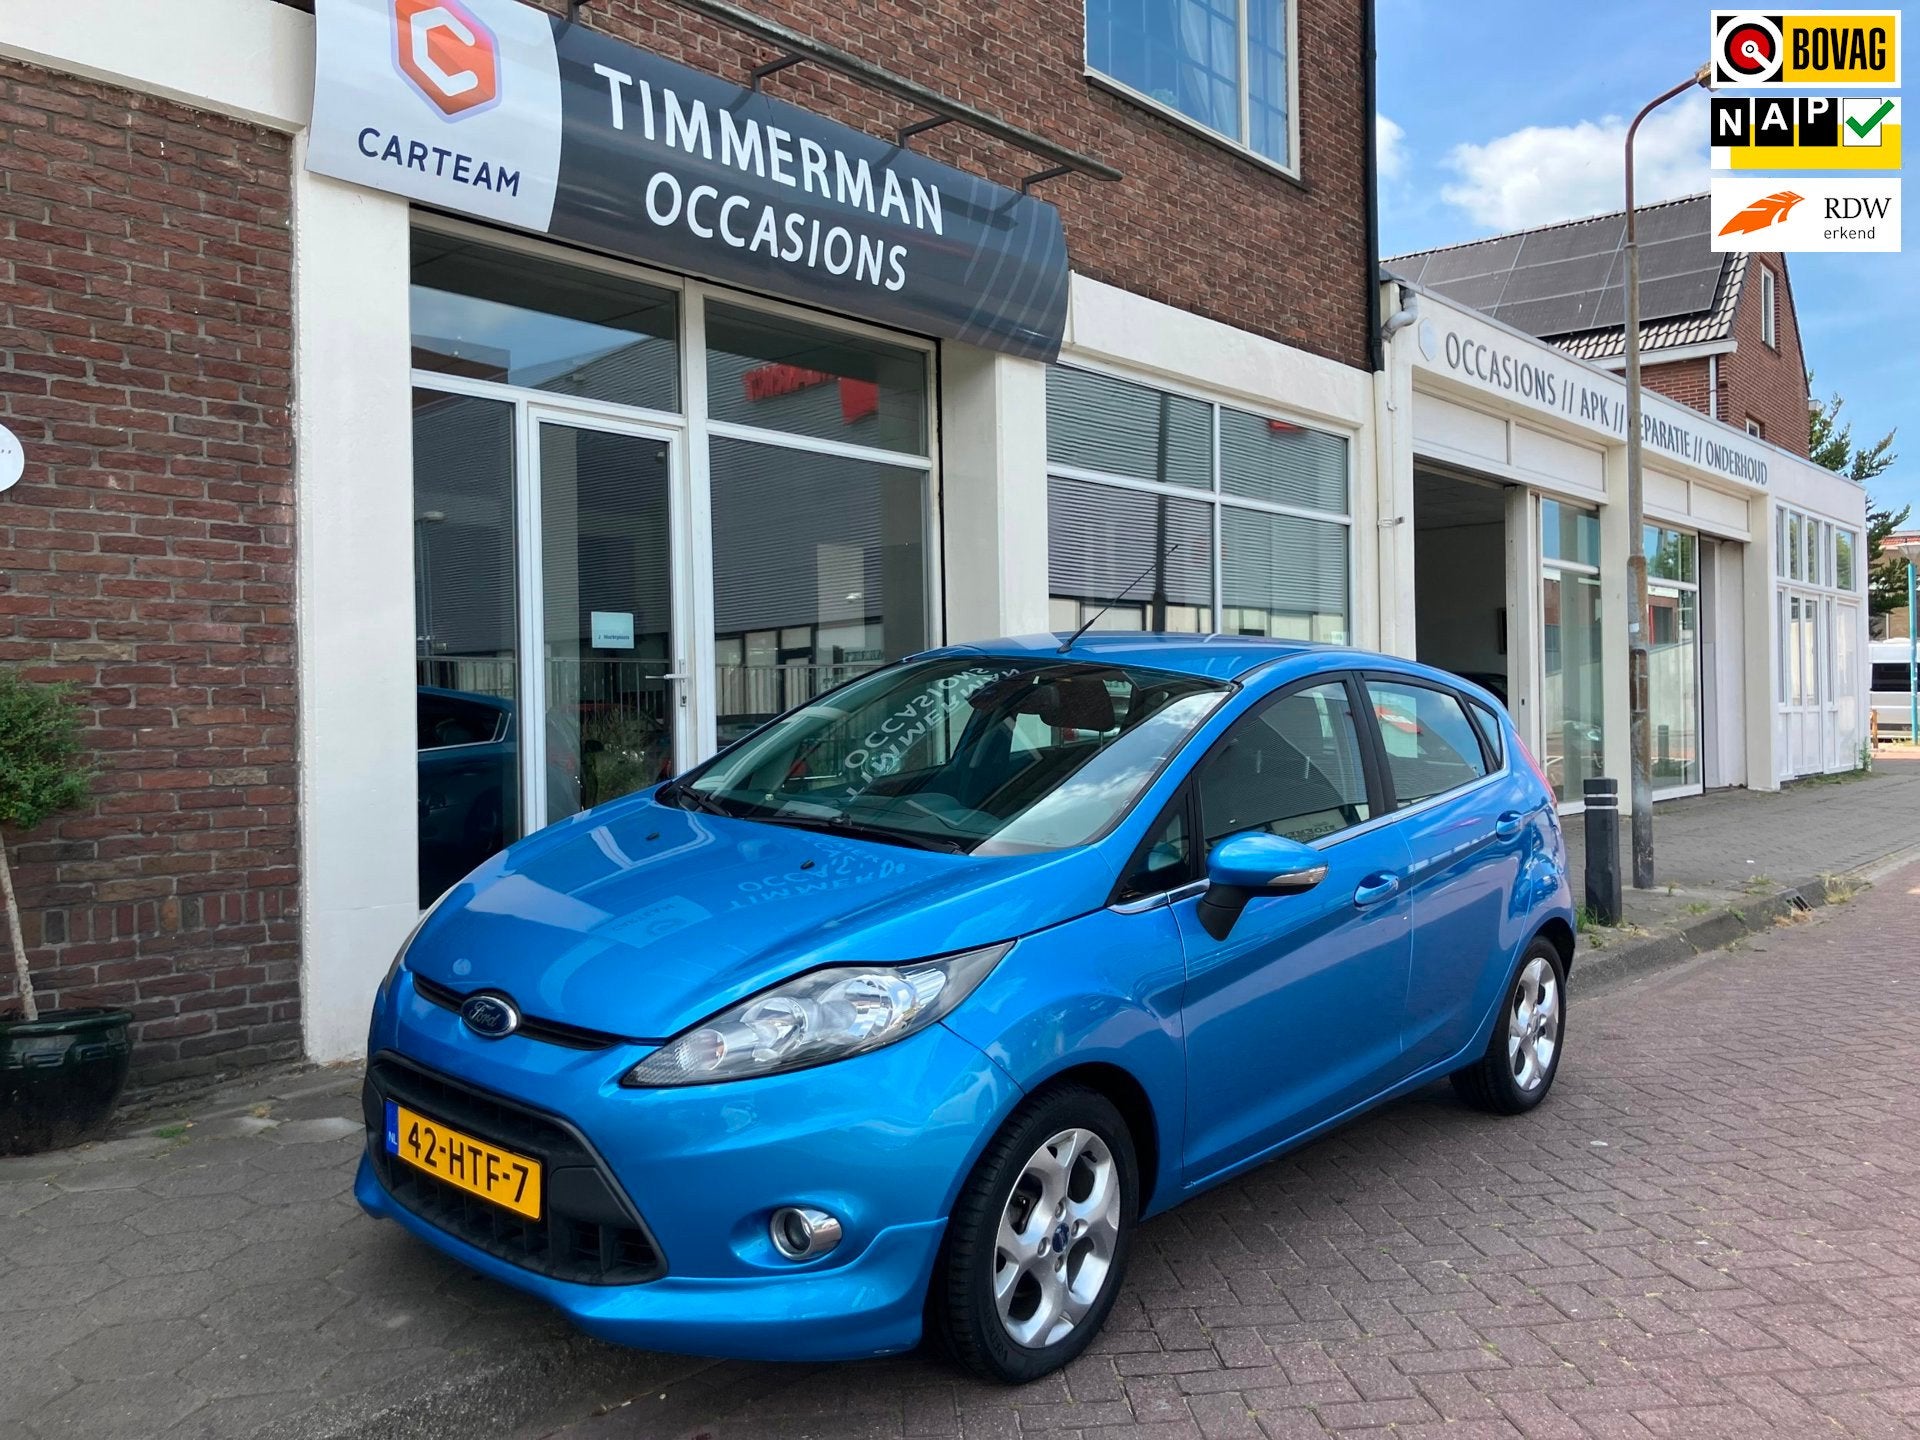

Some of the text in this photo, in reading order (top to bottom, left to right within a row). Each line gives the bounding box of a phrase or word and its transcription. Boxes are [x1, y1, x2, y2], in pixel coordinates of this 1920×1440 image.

[358, 127, 521, 198] CARTEAM
[593, 63, 943, 235] TIMMERMAN
[645, 171, 908, 292] OCCASIONS
[1446, 331, 1556, 406] OCCASIONS
[1580, 387, 1610, 427] APK
[1640, 411, 1691, 458] PARATIE
[1706, 443, 1768, 485] ONDERHOUD
[471, 1001, 501, 1028] Ford
[388, 1130, 398, 1146] NL
[408, 1121, 529, 1203] 42-HTF-7
